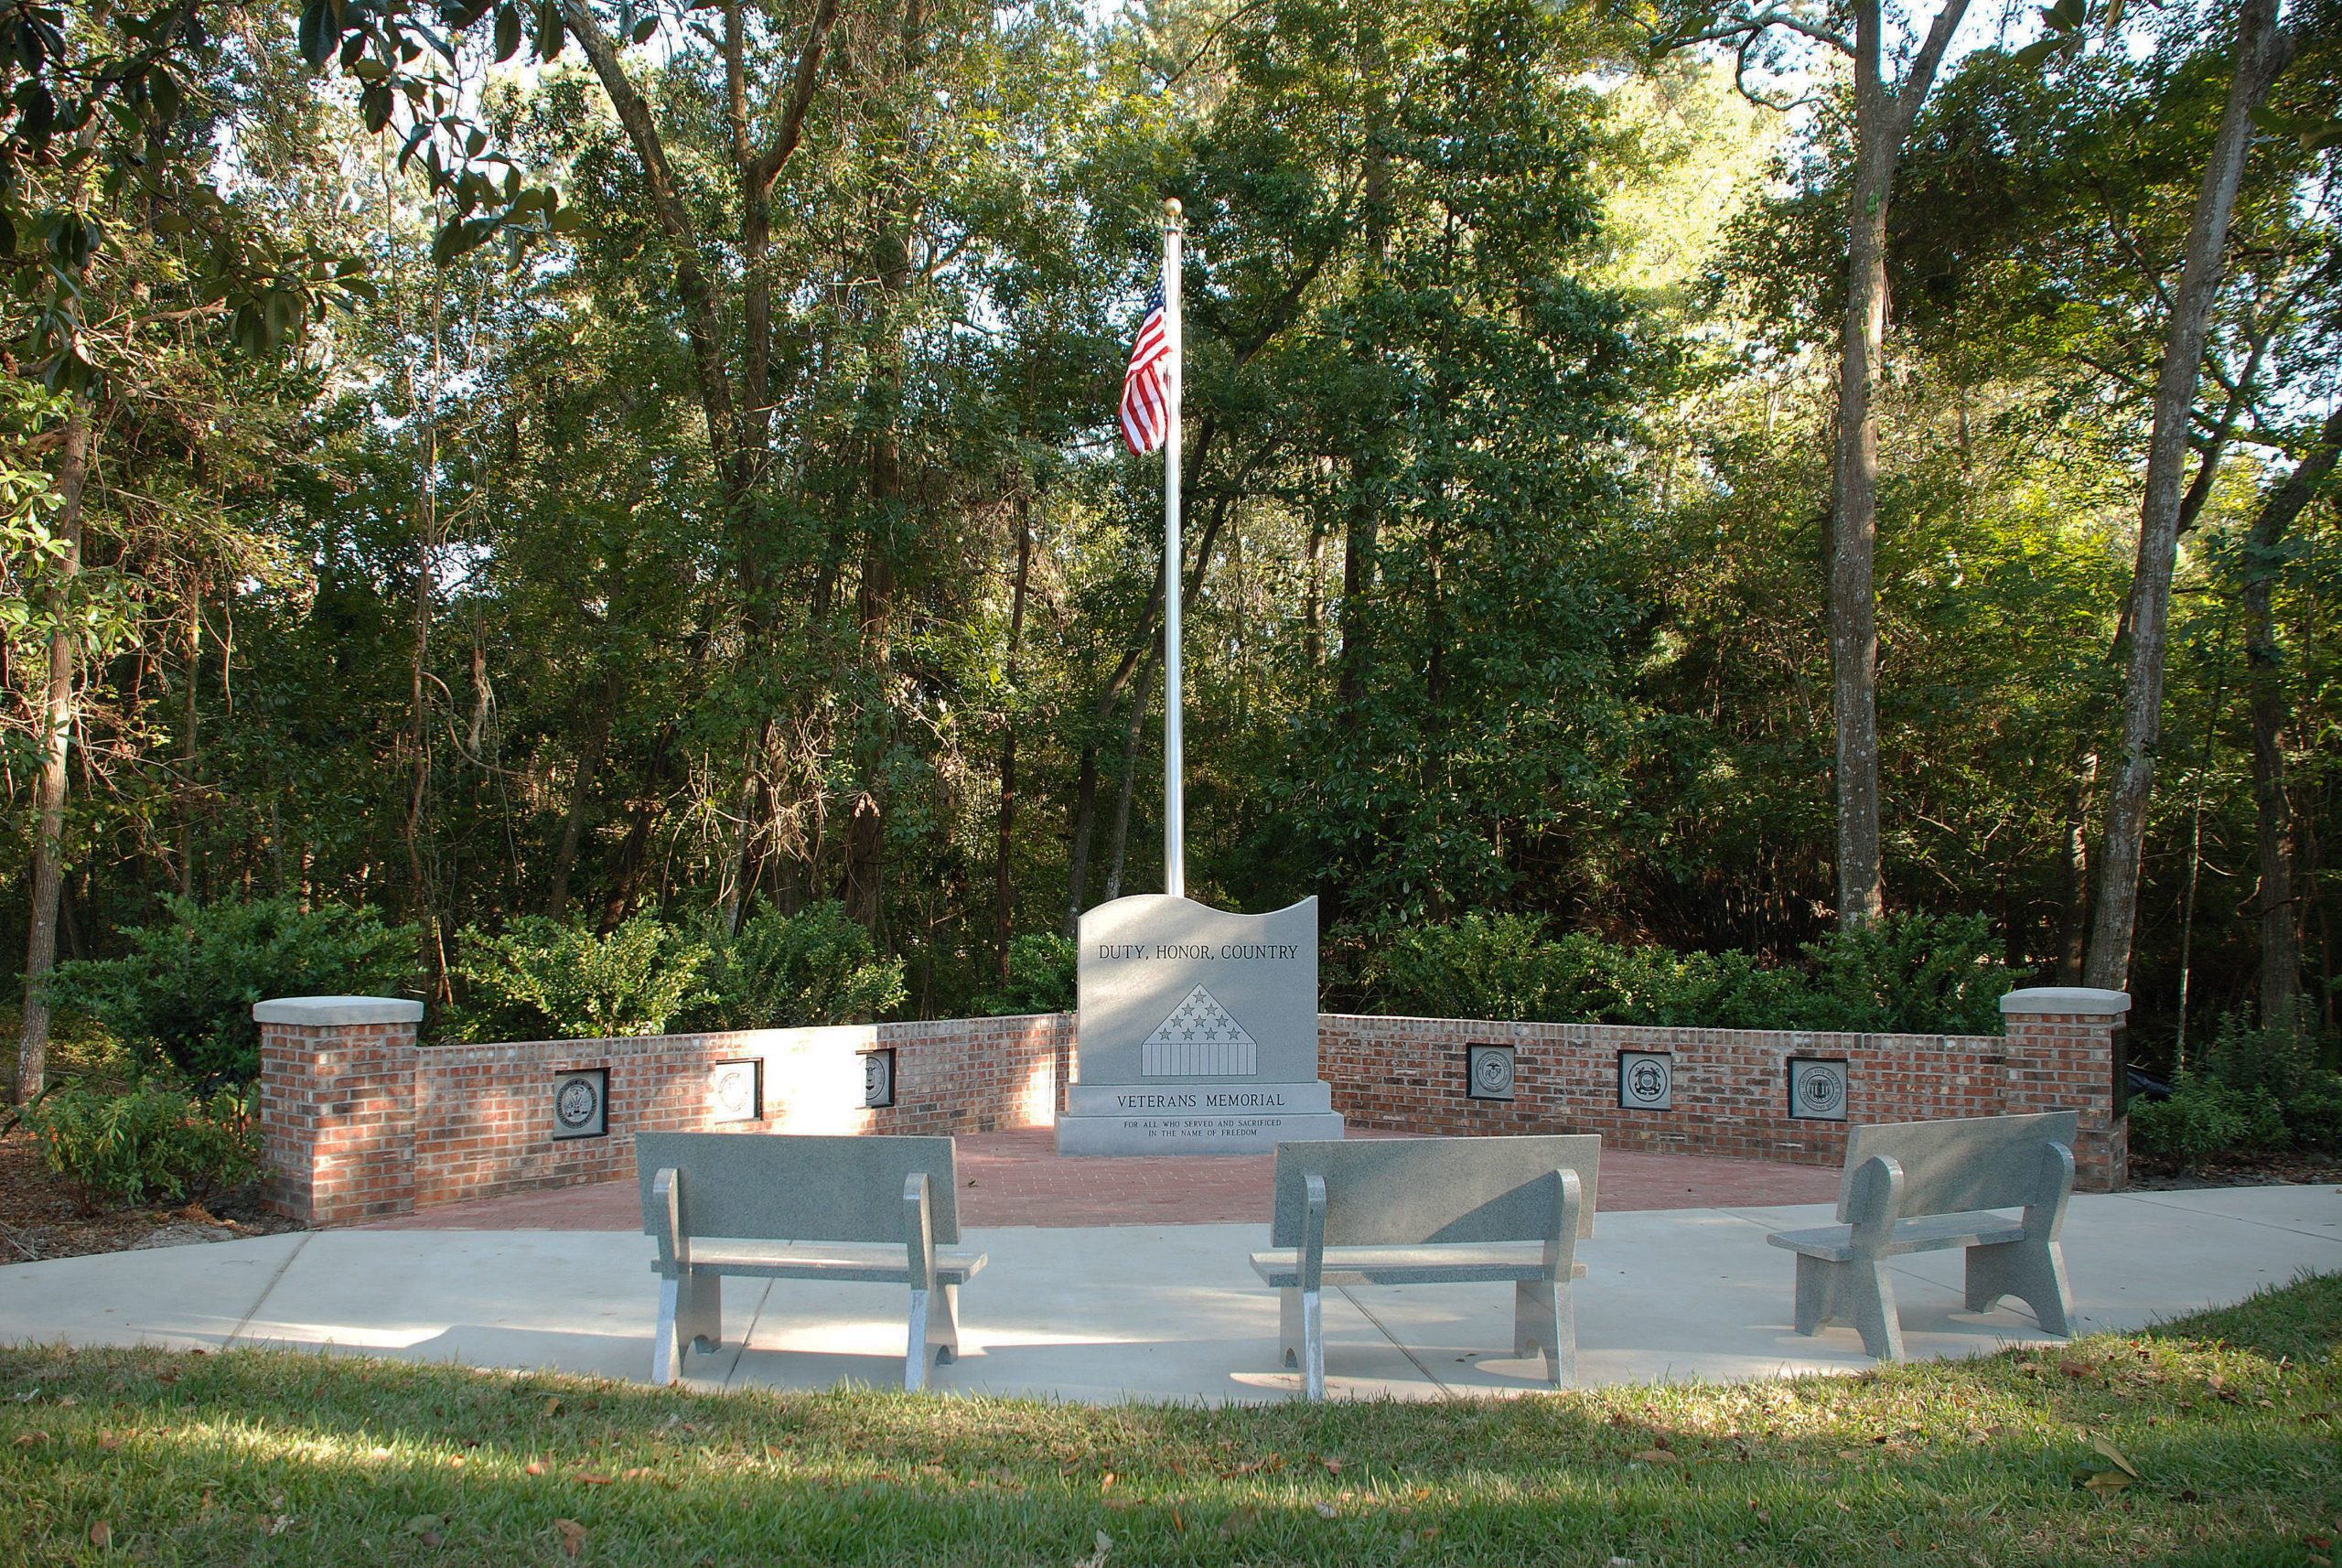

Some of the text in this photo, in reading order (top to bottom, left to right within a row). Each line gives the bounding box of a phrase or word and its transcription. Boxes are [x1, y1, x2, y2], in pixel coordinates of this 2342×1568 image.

[1099, 944, 1299, 961] DUTY, HONOR, COUNTRY
[1116, 1093, 1285, 1108] VETERANS MEMORIAL
[1238, 1119, 1282, 1127] SACRIFICED
